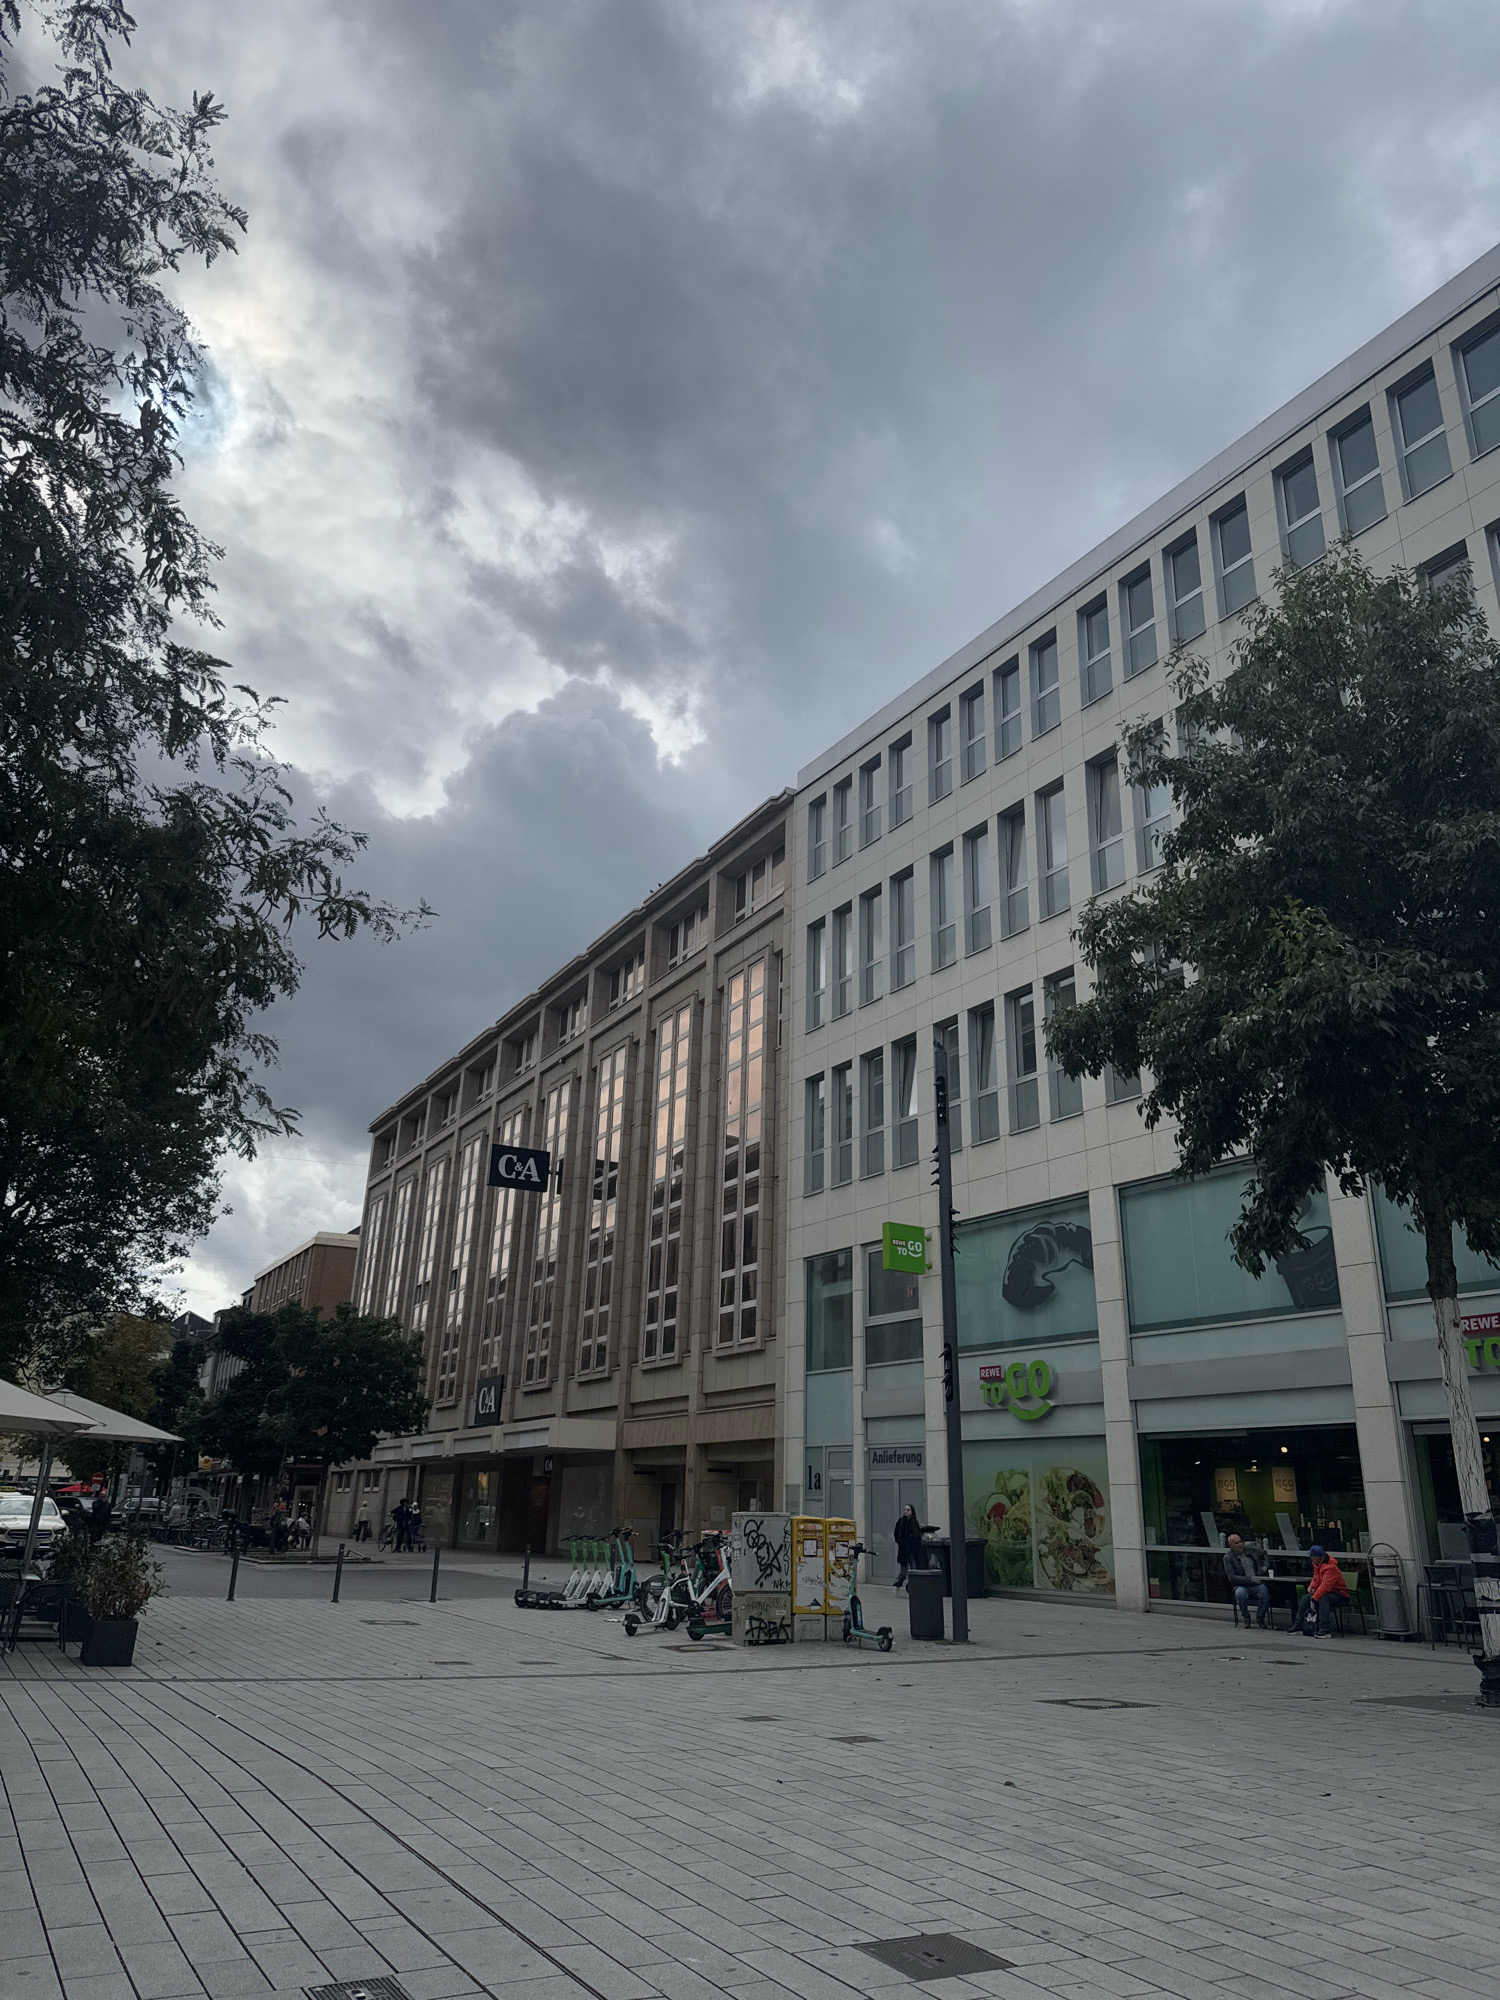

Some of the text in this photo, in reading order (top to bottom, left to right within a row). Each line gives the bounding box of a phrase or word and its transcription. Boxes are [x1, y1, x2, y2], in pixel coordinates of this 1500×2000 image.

[498, 1154, 541, 1182] C&A
[892, 1239, 906, 1247] REWE
[897, 1240, 923, 1256] TO GO
[1461, 1316, 1500, 1332] REWE
[980, 1367, 1001, 1378] REWE
[980, 1360, 1051, 1405] TO GO
[478, 1385, 496, 1414] C&A
[872, 1450, 922, 1466] Anlieferung
[1224, 1479, 1235, 1488] GO
